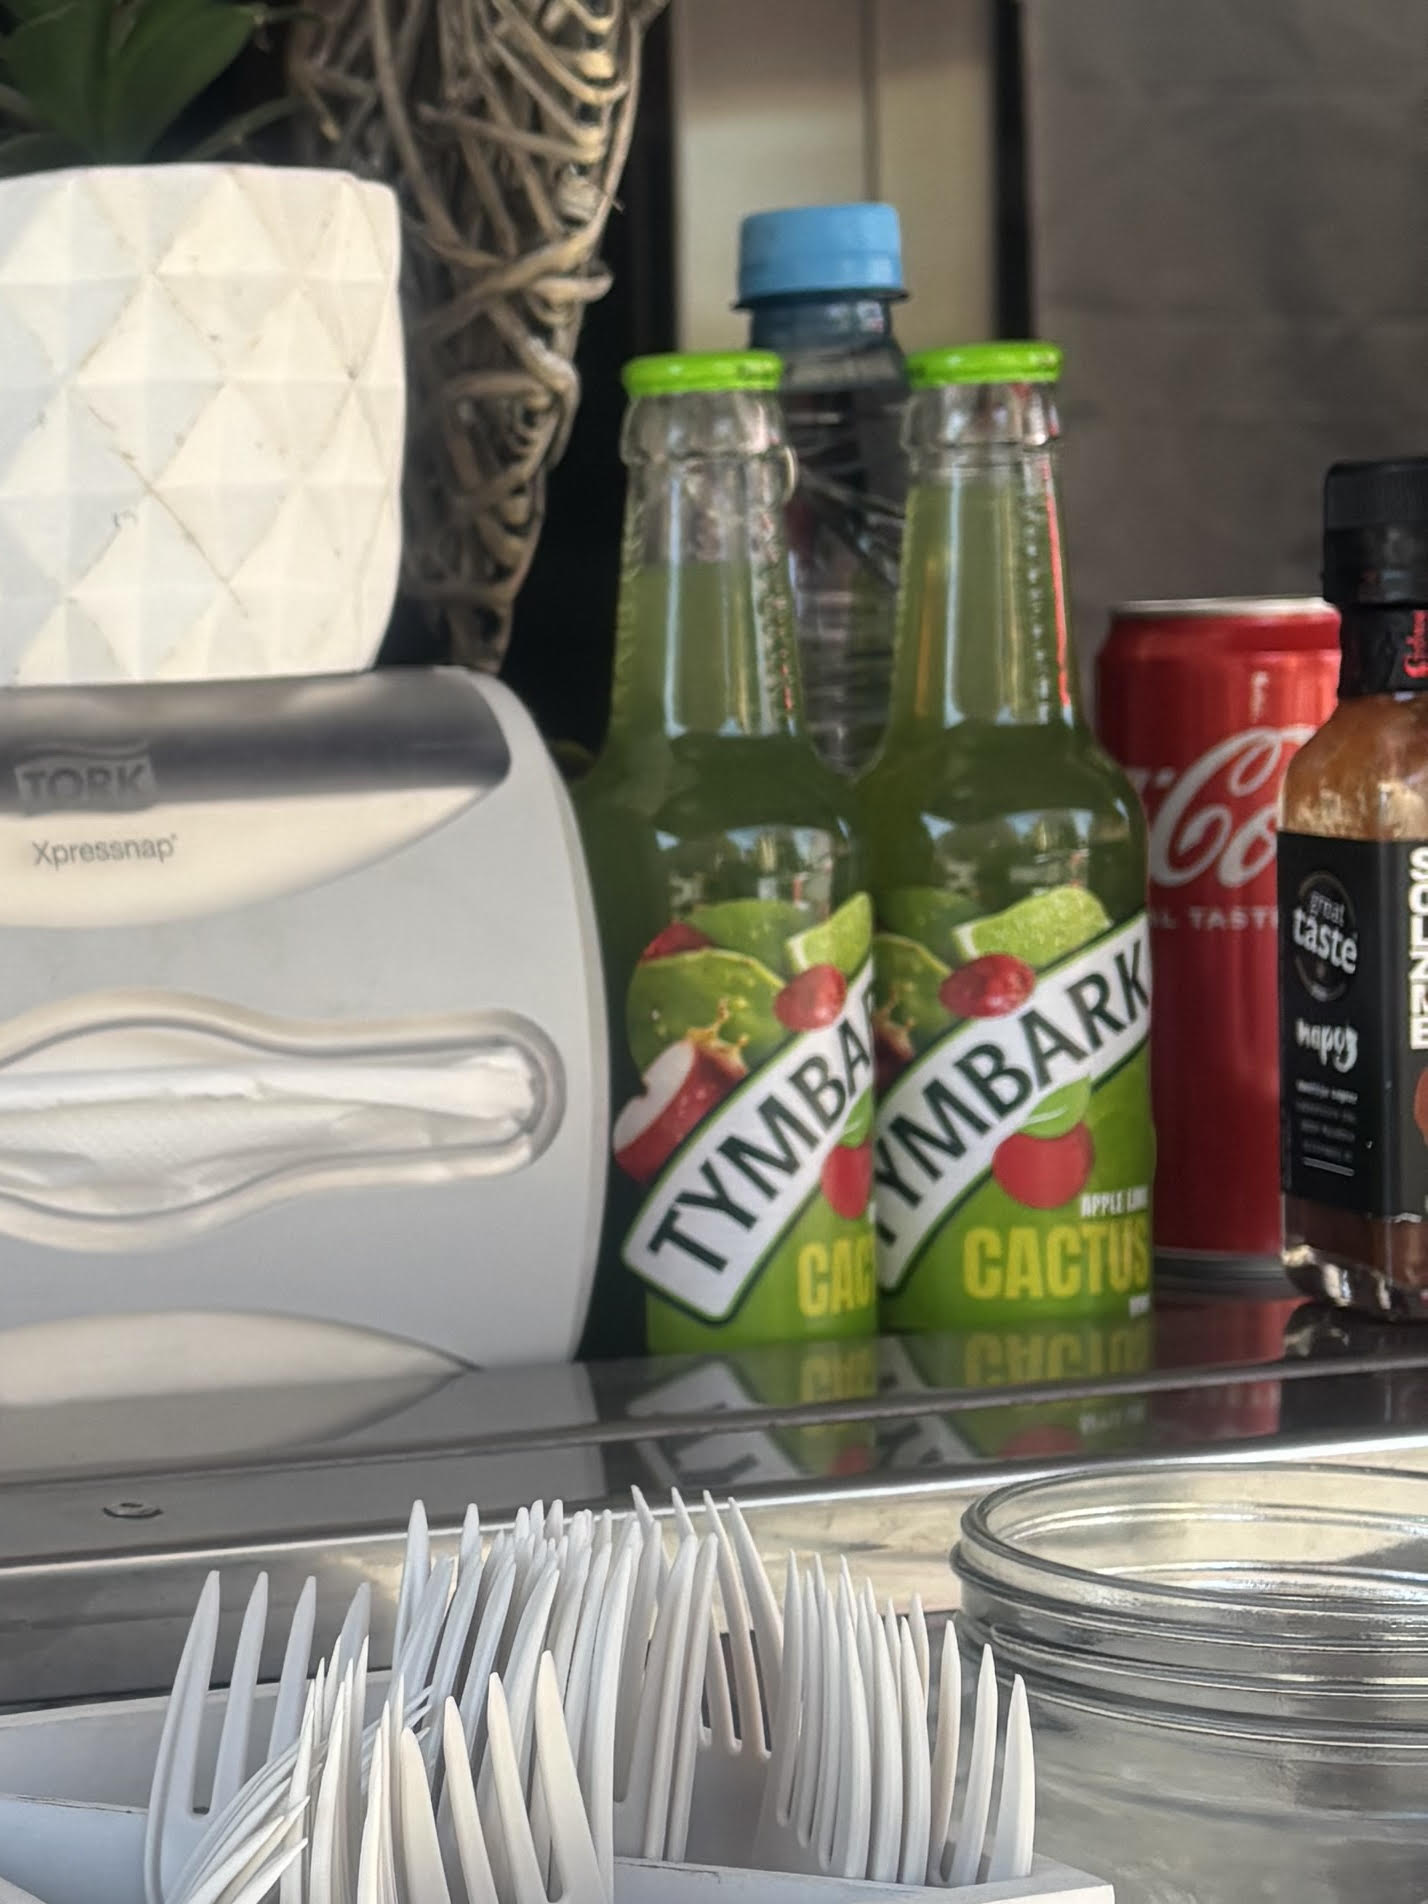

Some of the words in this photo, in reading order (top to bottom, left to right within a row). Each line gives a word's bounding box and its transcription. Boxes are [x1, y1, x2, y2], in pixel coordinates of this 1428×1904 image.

[21, 763, 146, 802] TORK
[1188, 904, 1278, 932] TAST
[1293, 907, 1358, 974] taste
[797, 1235, 875, 1318] CAC
[962, 1215, 1150, 1300] CACTUS
